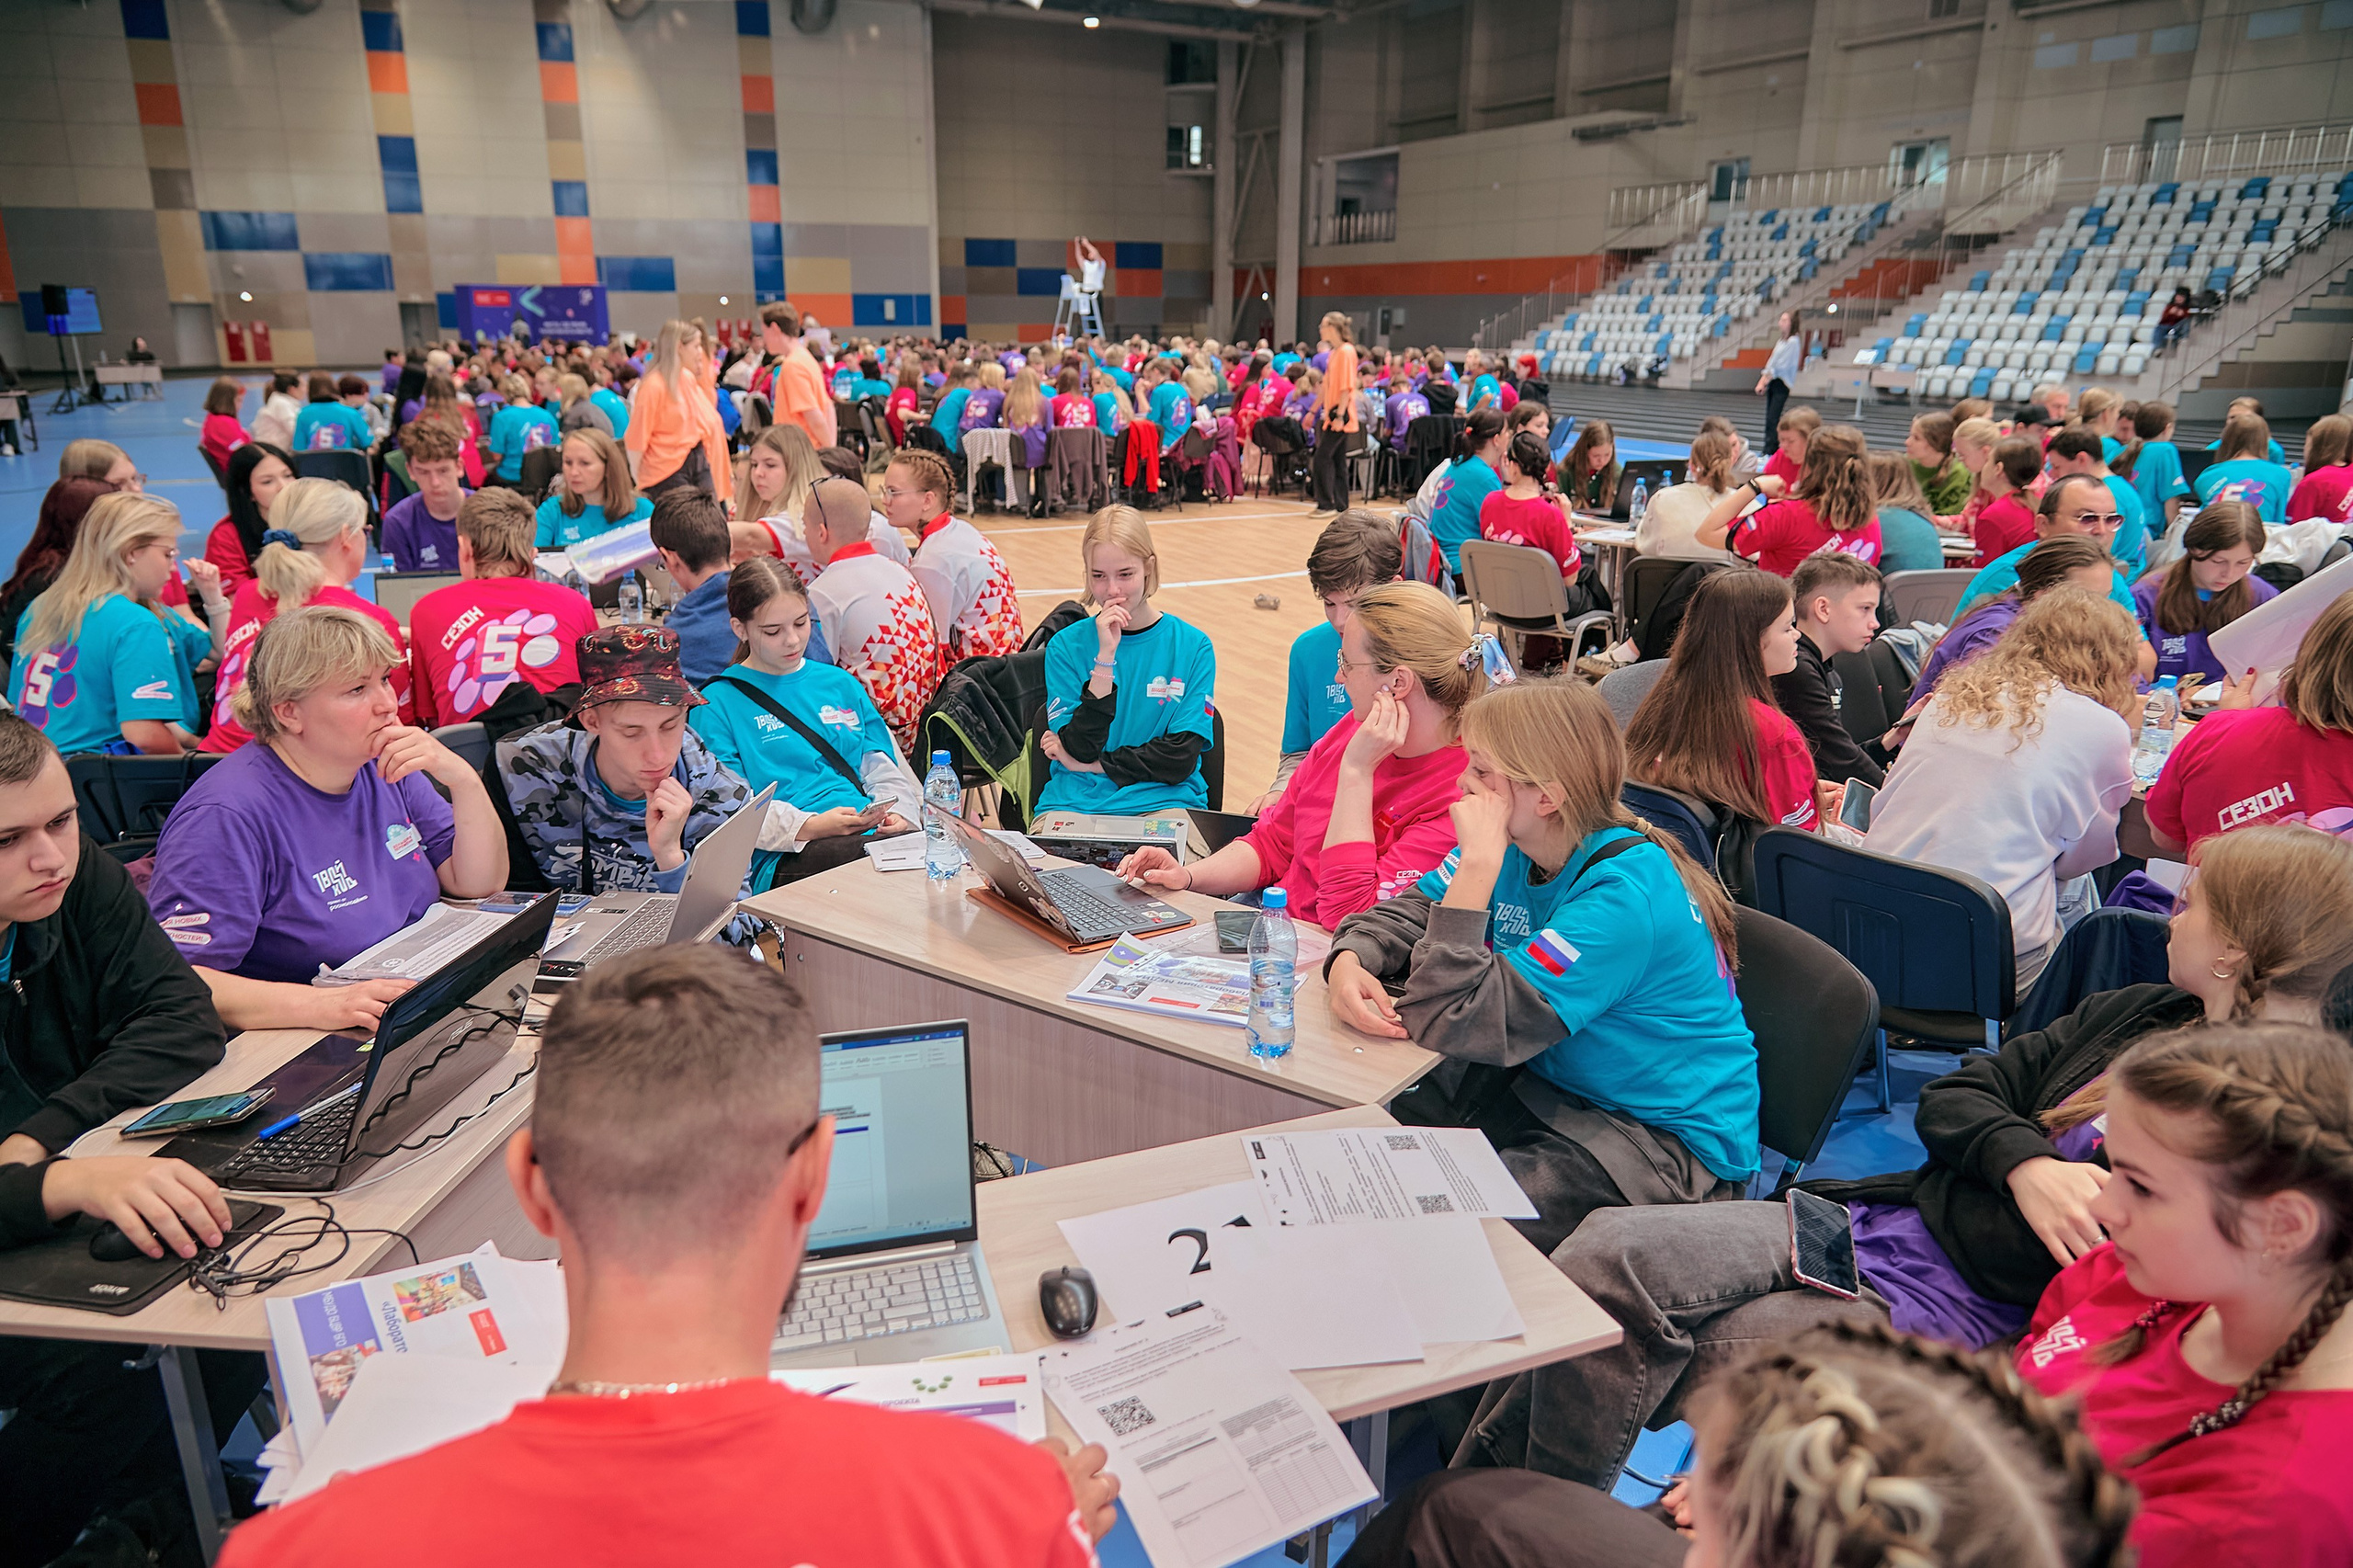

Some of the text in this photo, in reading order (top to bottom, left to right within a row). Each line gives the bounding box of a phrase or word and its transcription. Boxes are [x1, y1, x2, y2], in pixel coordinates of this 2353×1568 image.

[441, 606, 484, 650] СЕЗОН
[481, 626, 522, 674] 5
[26, 652, 60, 707] 5
[2217, 781, 2295, 831] СЕЗОН
